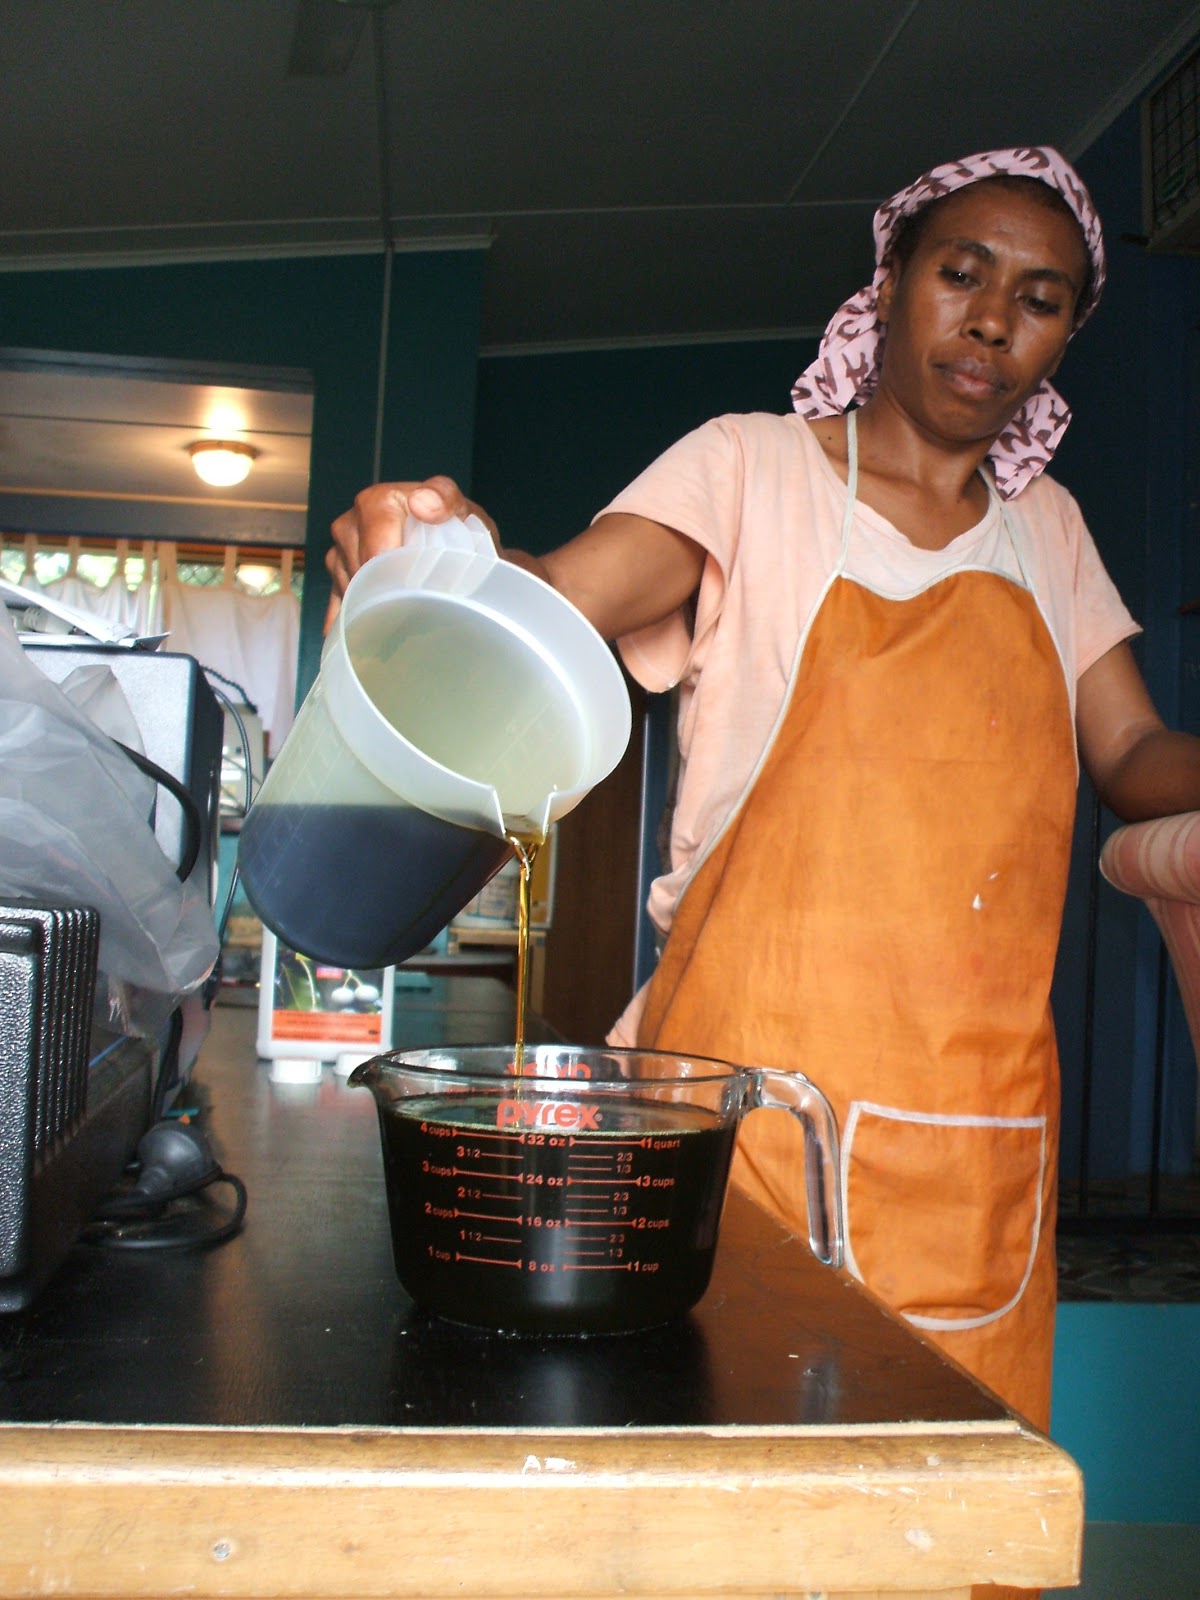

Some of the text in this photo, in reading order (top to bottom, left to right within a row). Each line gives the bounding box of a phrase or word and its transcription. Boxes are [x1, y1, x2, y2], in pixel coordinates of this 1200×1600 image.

[496, 1099, 599, 1130] pyrex
[420, 1122, 450, 1139] 4 cups
[527, 1135, 566, 1147] 32 oz
[645, 1137, 680, 1150] 1 quart
[456, 1145, 465, 1157] 3
[422, 1160, 452, 1177] 3 cups
[526, 1174, 564, 1186] 24 oz
[642, 1175, 675, 1188] 3 cups
[457, 1186, 466, 1198] 2
[424, 1202, 454, 1219] 2 cups
[526, 1216, 562, 1228] 16 oz
[637, 1217, 670, 1230] 2 cups
[460, 1229, 466, 1240] 1
[427, 1246, 451, 1261] 1 cup
[528, 1260, 556, 1273] 8 oz
[633, 1261, 659, 1273] 1 cup
